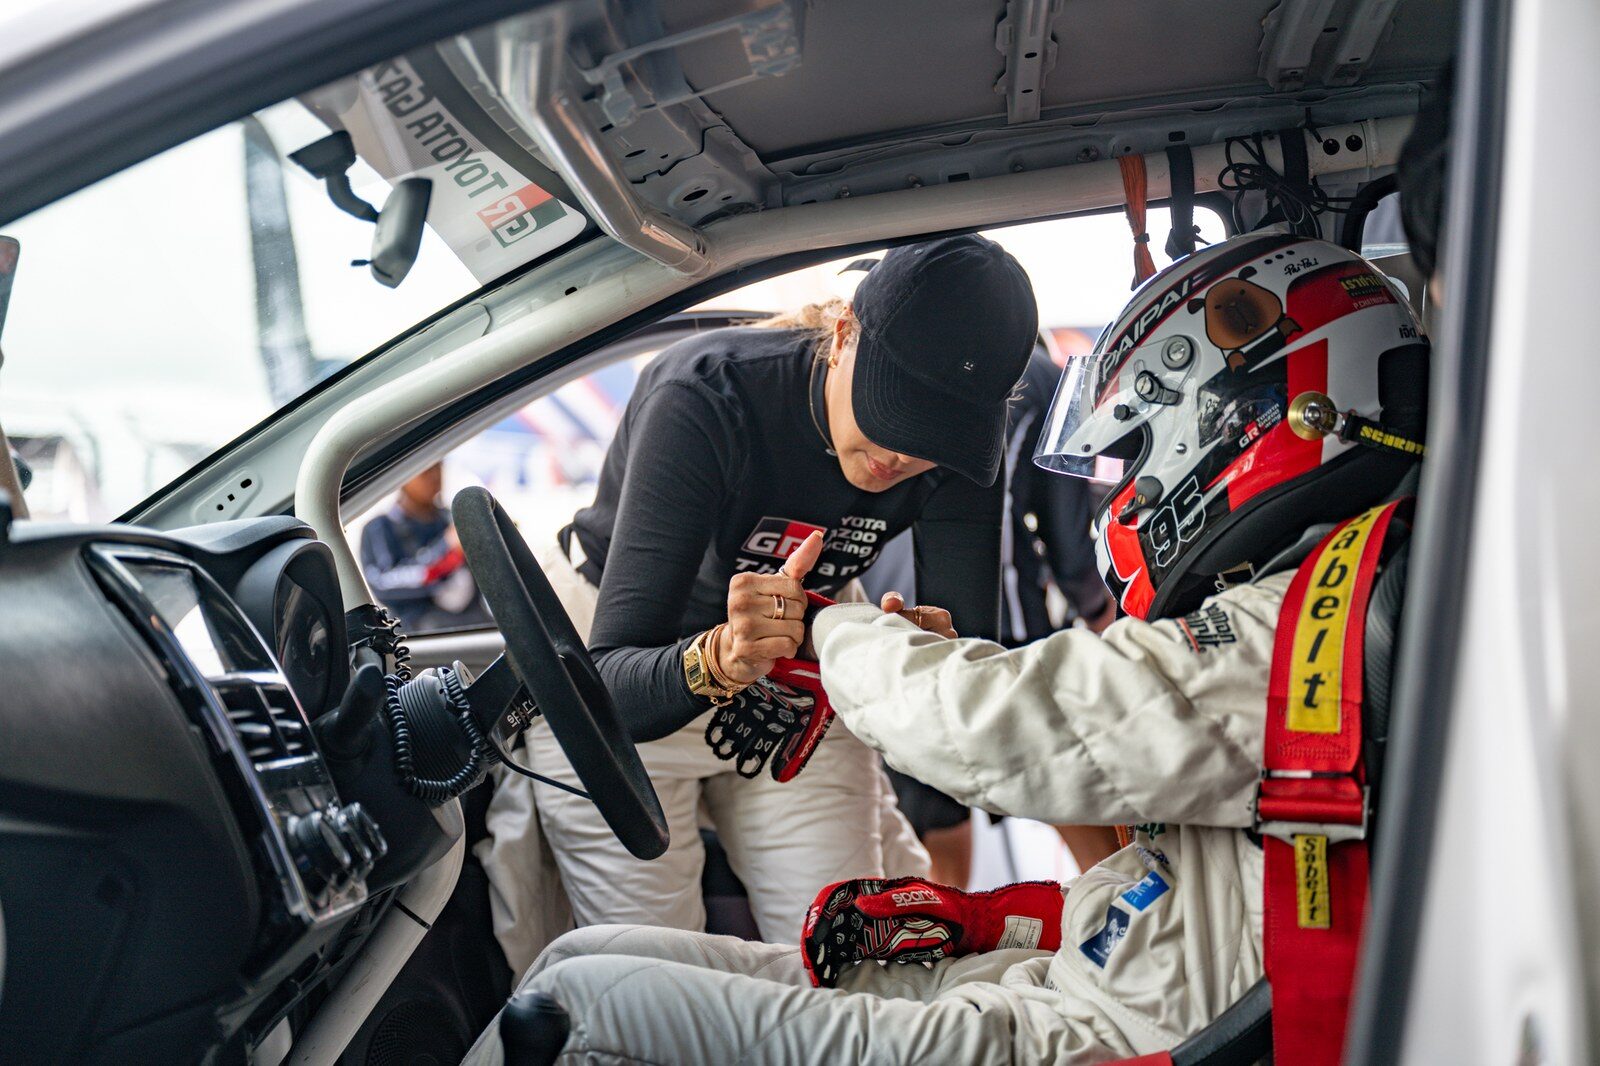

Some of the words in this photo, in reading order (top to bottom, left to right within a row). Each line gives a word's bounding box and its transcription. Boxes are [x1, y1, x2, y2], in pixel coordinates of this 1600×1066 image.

[1102, 278, 1190, 383] PAIPAI
[1239, 427, 1260, 448] GR
[841, 516, 887, 531] YOTA
[1150, 475, 1207, 568] 95
[830, 528, 877, 544] ZOO
[827, 540, 873, 558] cing
[1303, 837, 1318, 921] Sabelt
